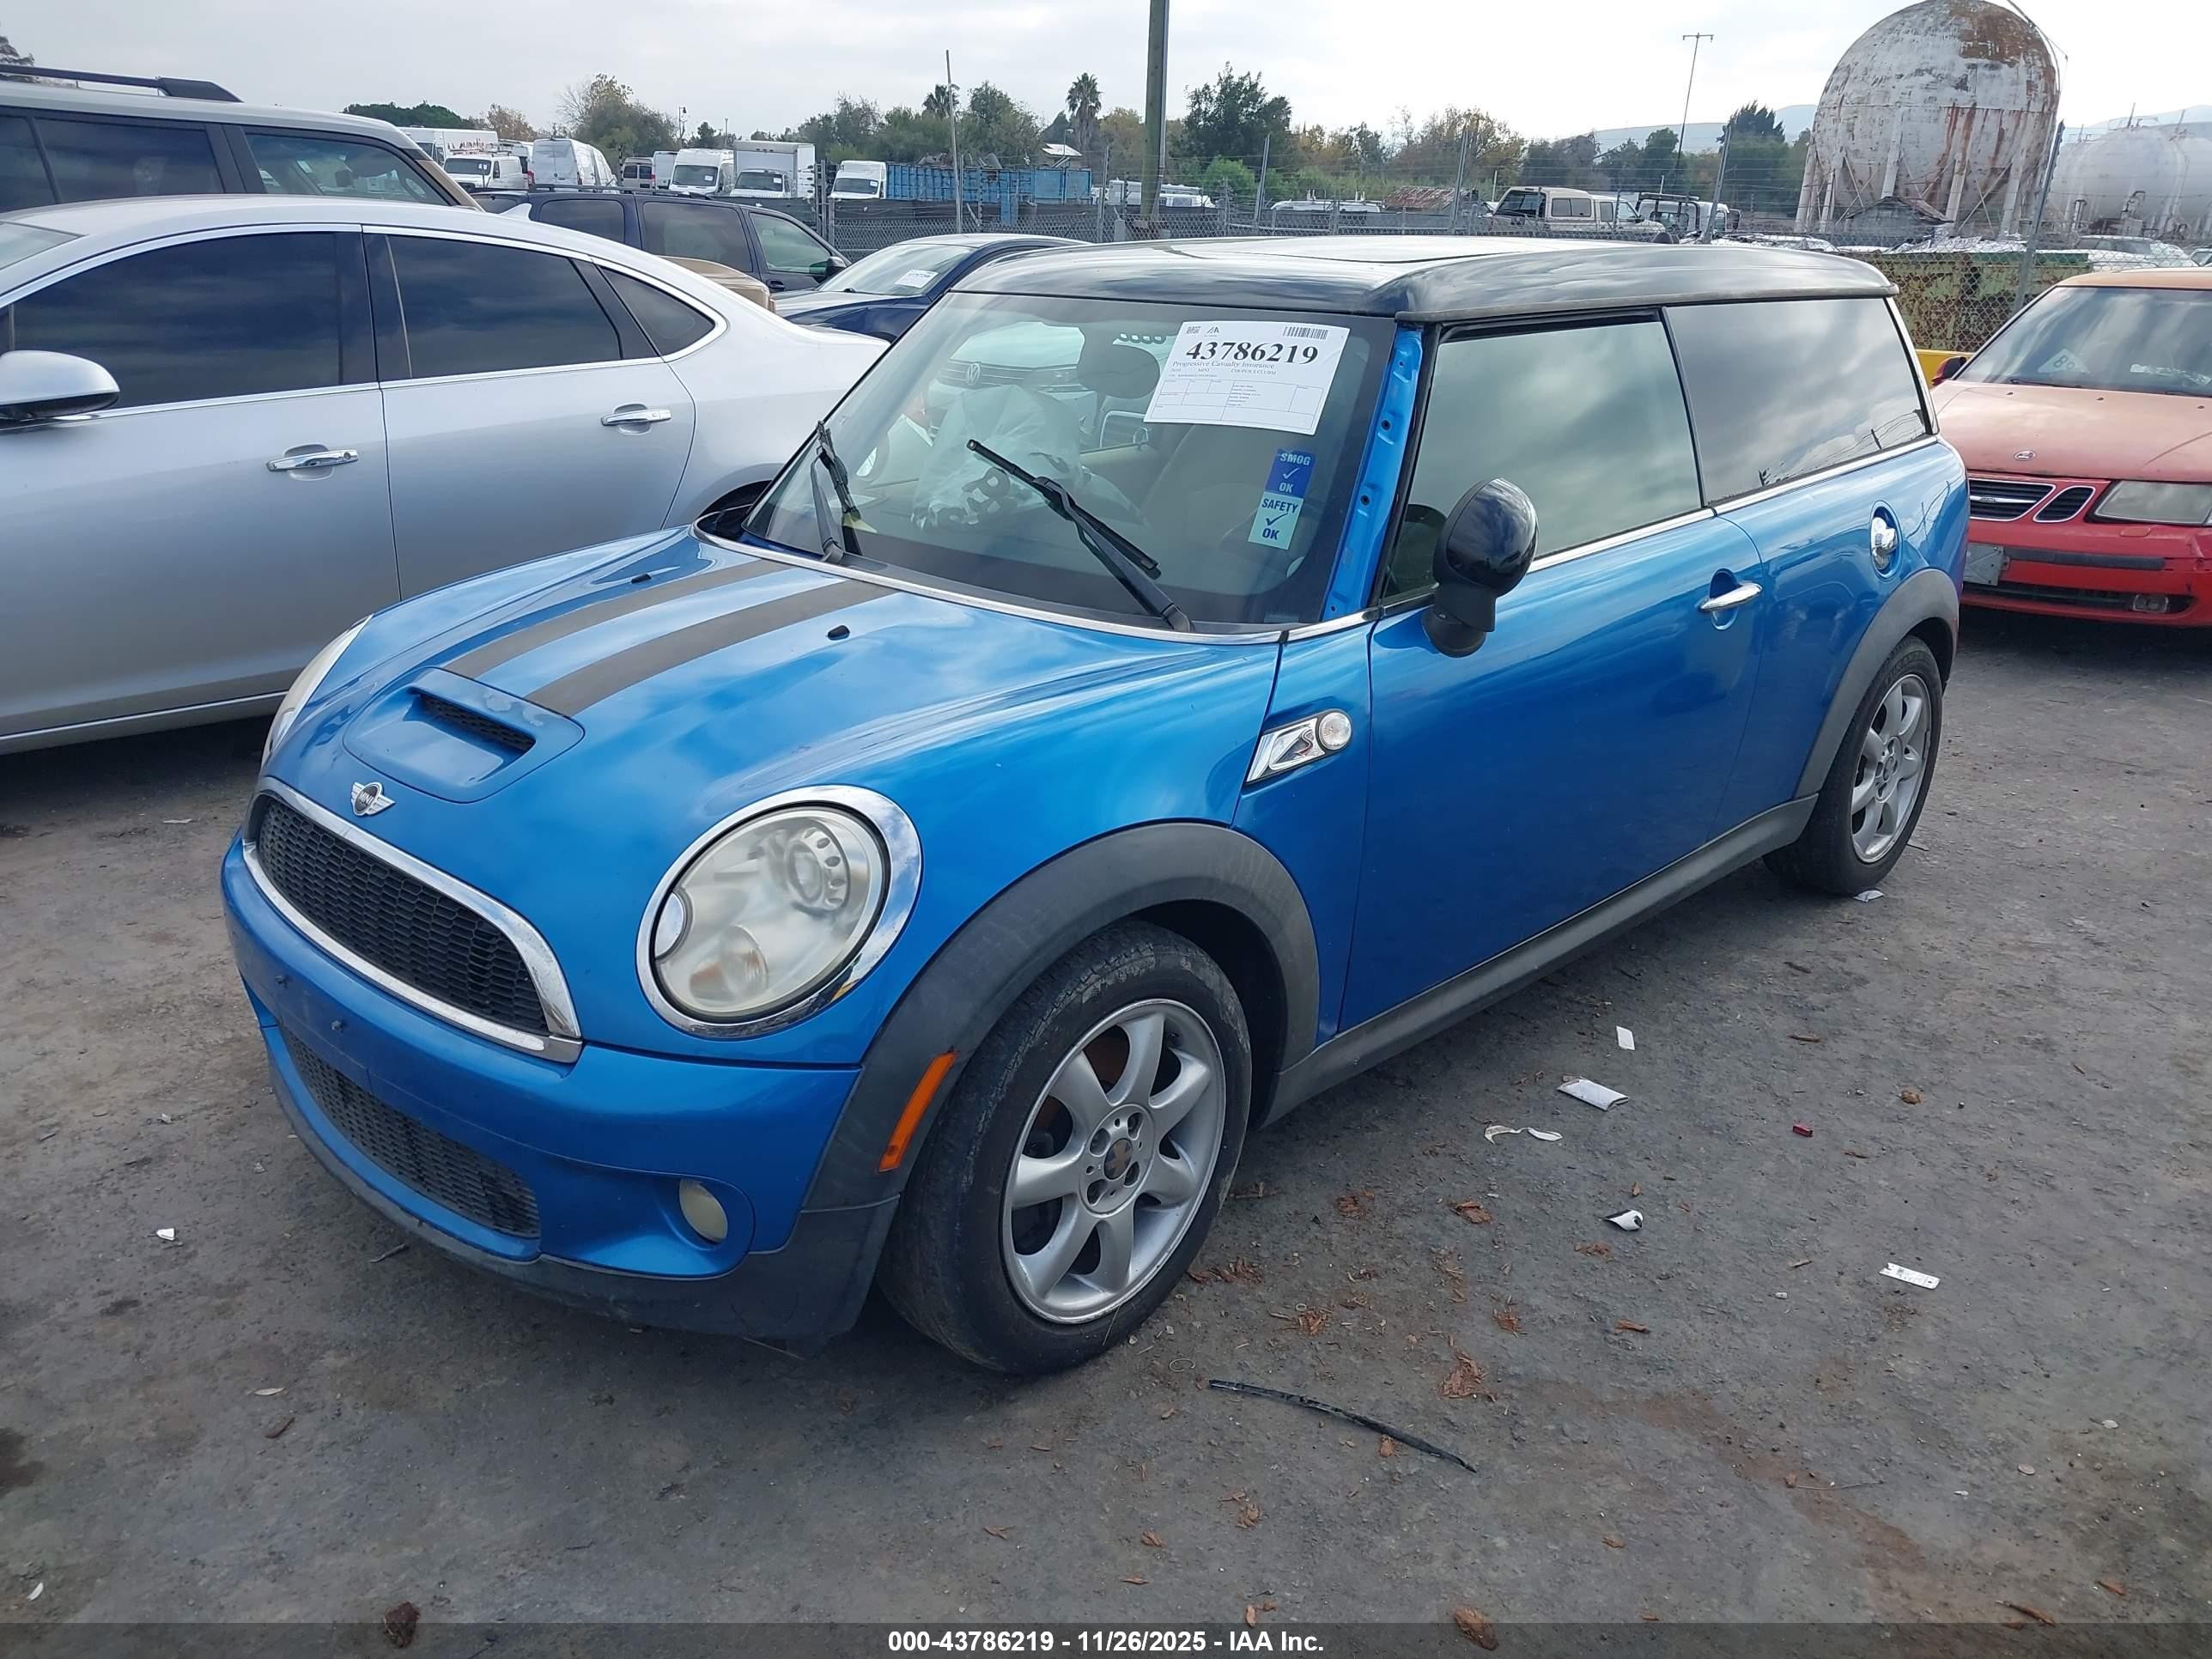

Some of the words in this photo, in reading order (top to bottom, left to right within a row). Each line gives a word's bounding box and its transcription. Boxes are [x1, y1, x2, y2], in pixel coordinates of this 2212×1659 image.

[1186, 342, 1319, 364] 43786219
[1279, 453, 1311, 465] SMOG
[1279, 482, 1294, 493] OK
[1261, 498, 1298, 514] SAFETY
[1262, 528, 1279, 540] OK
[359, 791, 374, 805] MINI
